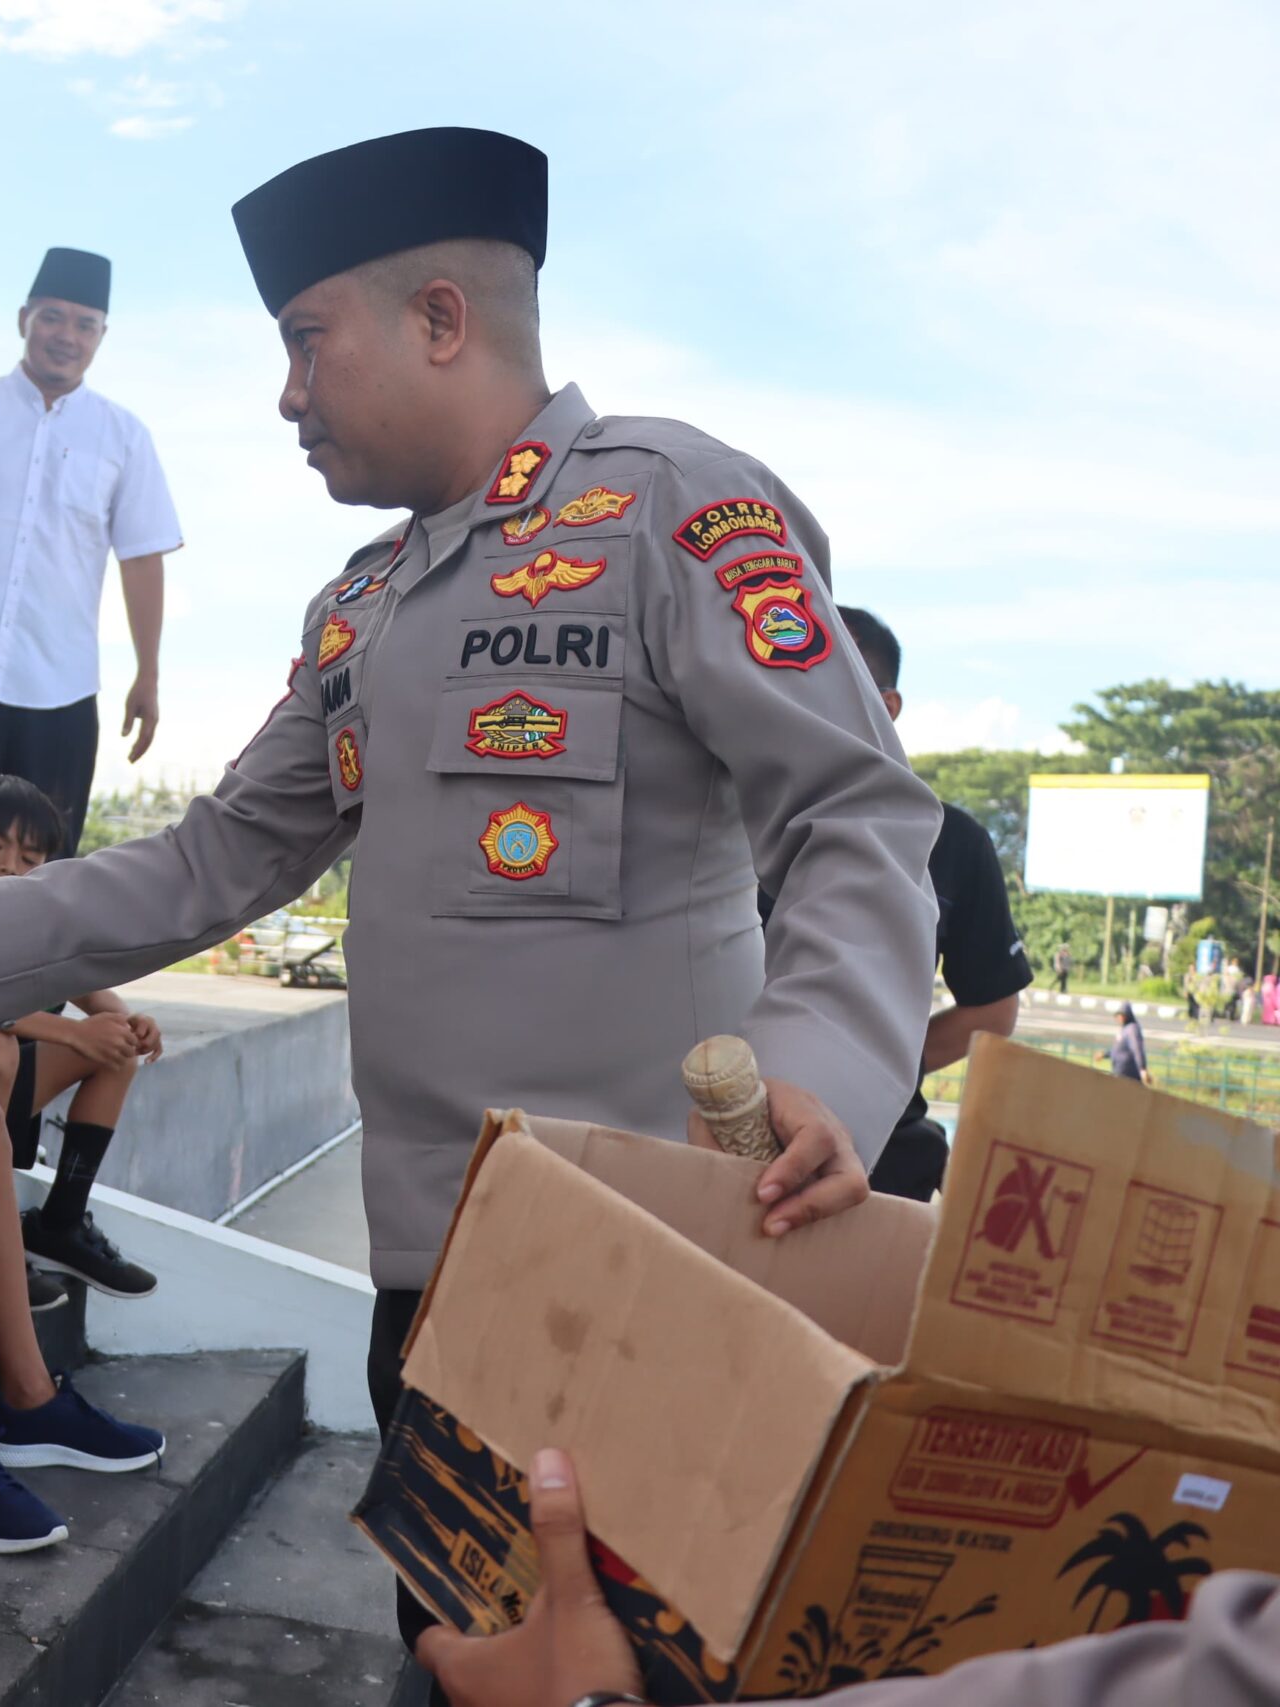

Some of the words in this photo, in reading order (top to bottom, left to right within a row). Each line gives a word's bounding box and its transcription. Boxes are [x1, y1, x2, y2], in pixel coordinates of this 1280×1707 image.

[690, 502, 776, 536] POLRES
[723, 566, 743, 583] NUSA
[742, 557, 775, 576] TENGGARA
[776, 556, 797, 569] BARAT
[460, 623, 609, 669] POLRI
[489, 740, 540, 753] SNIPER
